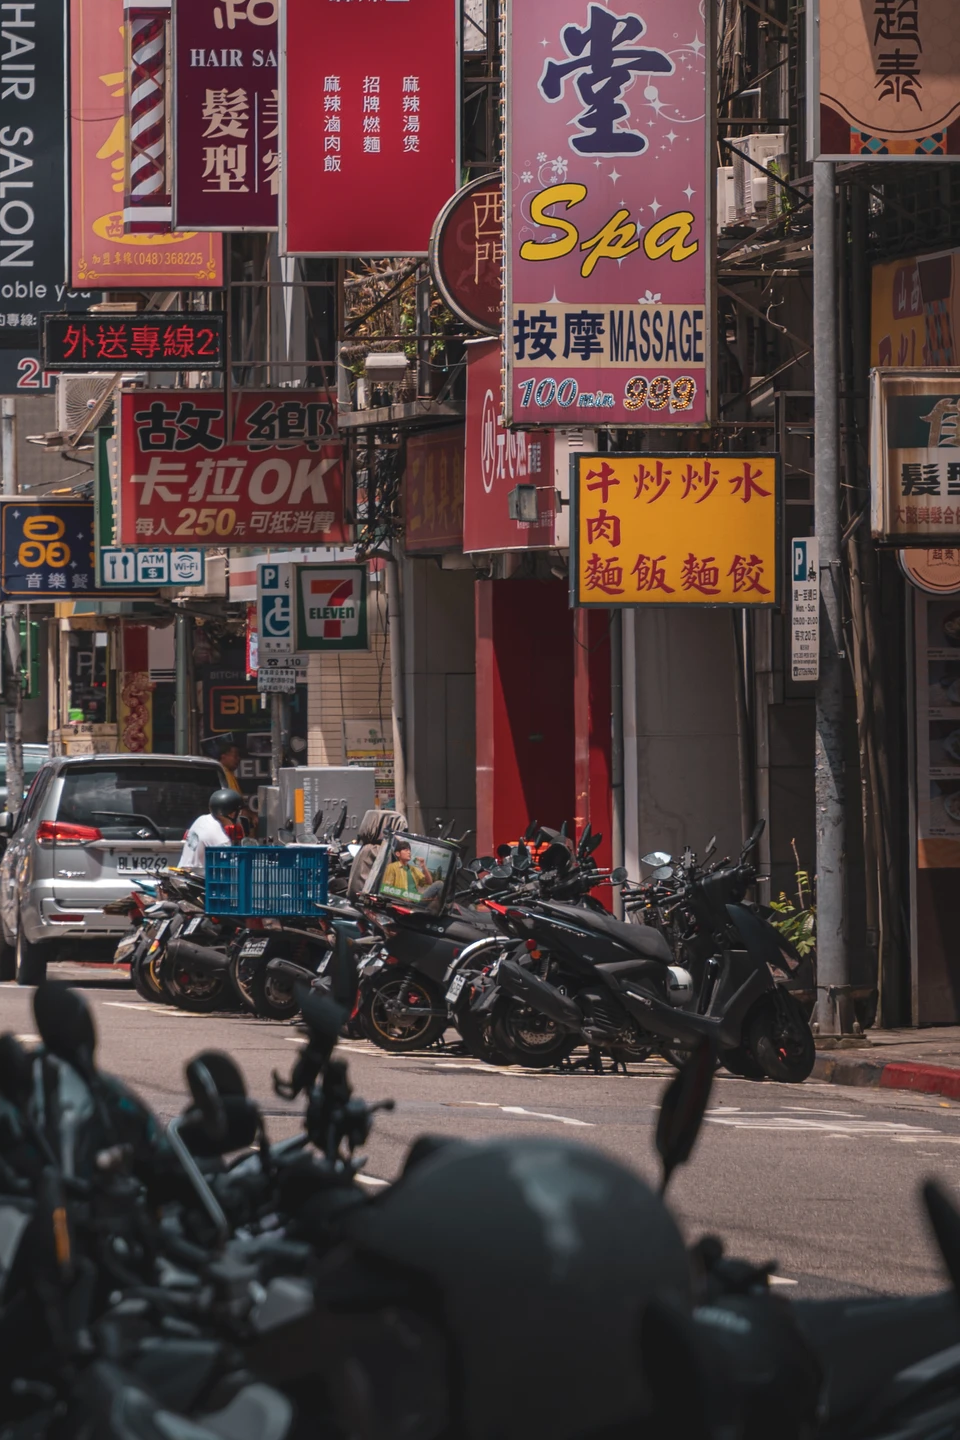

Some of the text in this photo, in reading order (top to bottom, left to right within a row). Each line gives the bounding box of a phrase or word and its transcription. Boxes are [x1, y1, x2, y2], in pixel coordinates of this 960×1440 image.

[0, 2, 36, 101] HAIR
[190, 49, 244, 68] HAIR
[202, 87, 250, 194] 髮型
[323, 75, 342, 173] 麻辣滷肉飯
[362, 75, 381, 154] 招牌燃麵
[402, 75, 420, 154] 麻辣湯煲
[519, 182, 700, 278] Spa
[62, 324, 220, 359] 外送專線2
[512, 309, 704, 363] 按摩 MASSAGE
[129, 456, 340, 505] 卡拉OK
[135, 508, 336, 537] 每人250元可抵消費
[583, 461, 626, 596] 牛肉麵
[629, 460, 676, 594] 炒飯
[680, 460, 722, 596] 炒麵
[725, 461, 773, 596] 水餃
[141, 554, 165, 564] ATM
[174, 561, 199, 571] Wi-Fi
[264, 568, 275, 586] P
[795, 547, 804, 575] P
[309, 606, 355, 620] ELEVEn
[284, 658, 301, 666] 110
